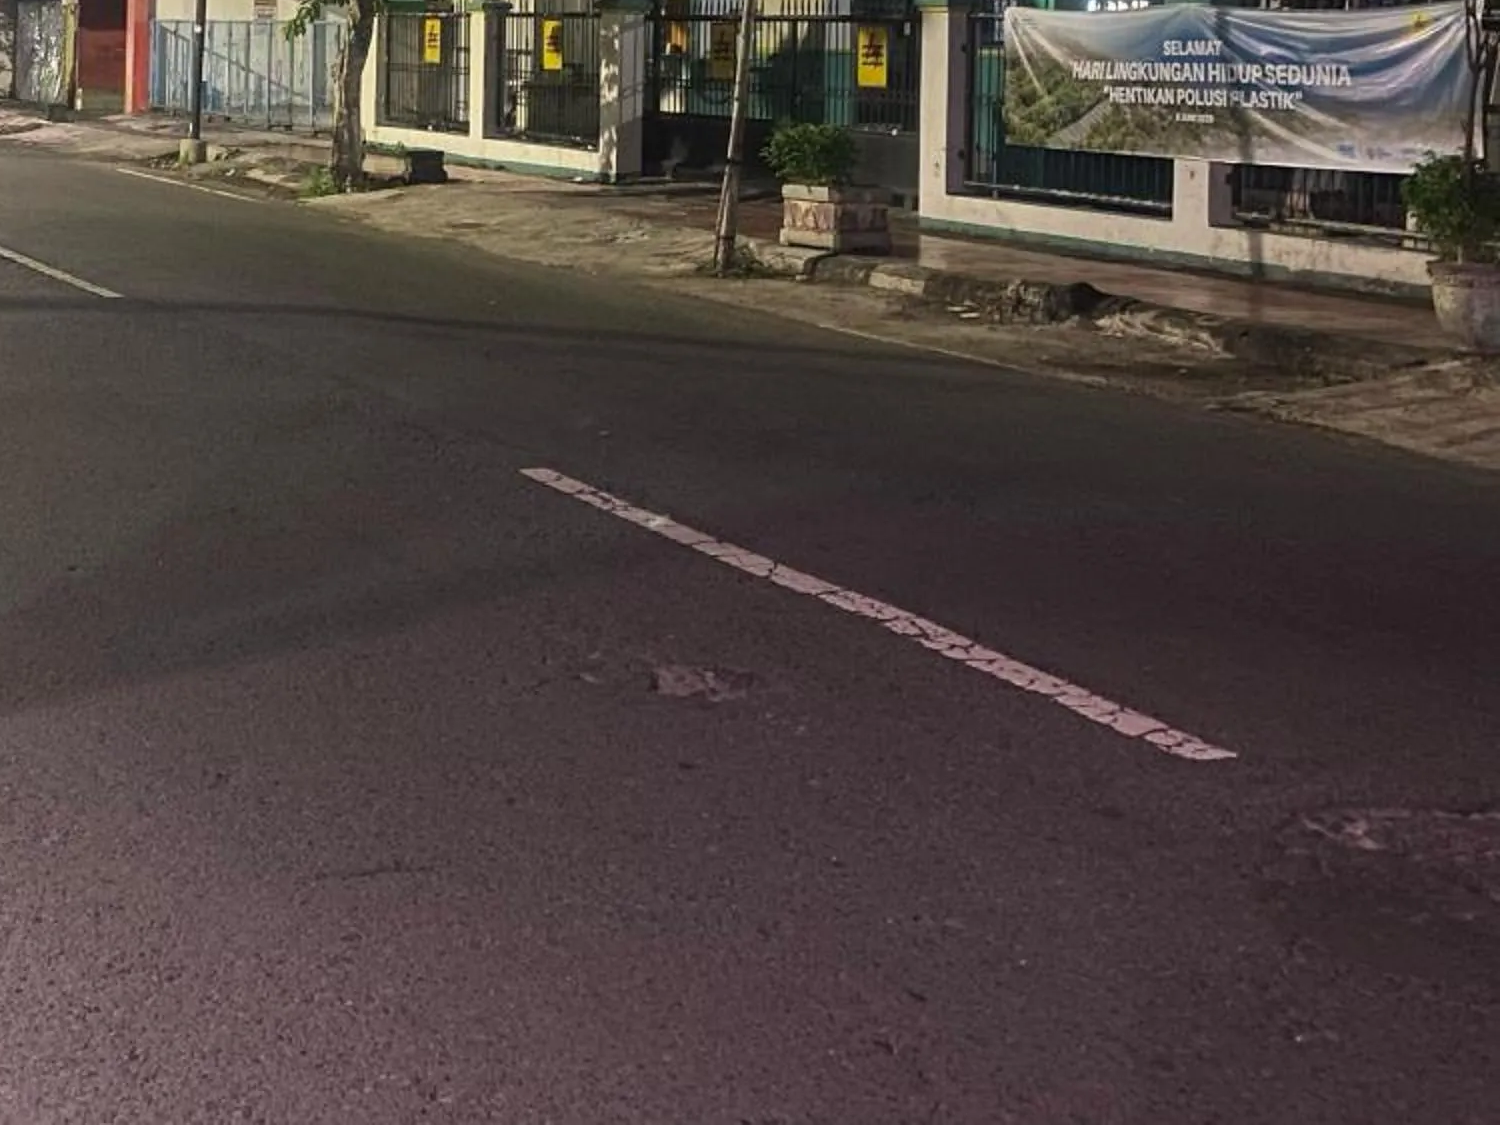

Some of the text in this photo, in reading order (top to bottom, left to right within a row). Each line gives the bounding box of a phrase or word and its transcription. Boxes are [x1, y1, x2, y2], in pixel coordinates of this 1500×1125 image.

[1163, 40, 1223, 57] SELAMAT
[1106, 61, 1205, 83] LINGKUNGAN
[1207, 62, 1263, 84] HIDUP
[1264, 63, 1352, 87] SEDUNIA
[1176, 88, 1227, 108] POLUSI
